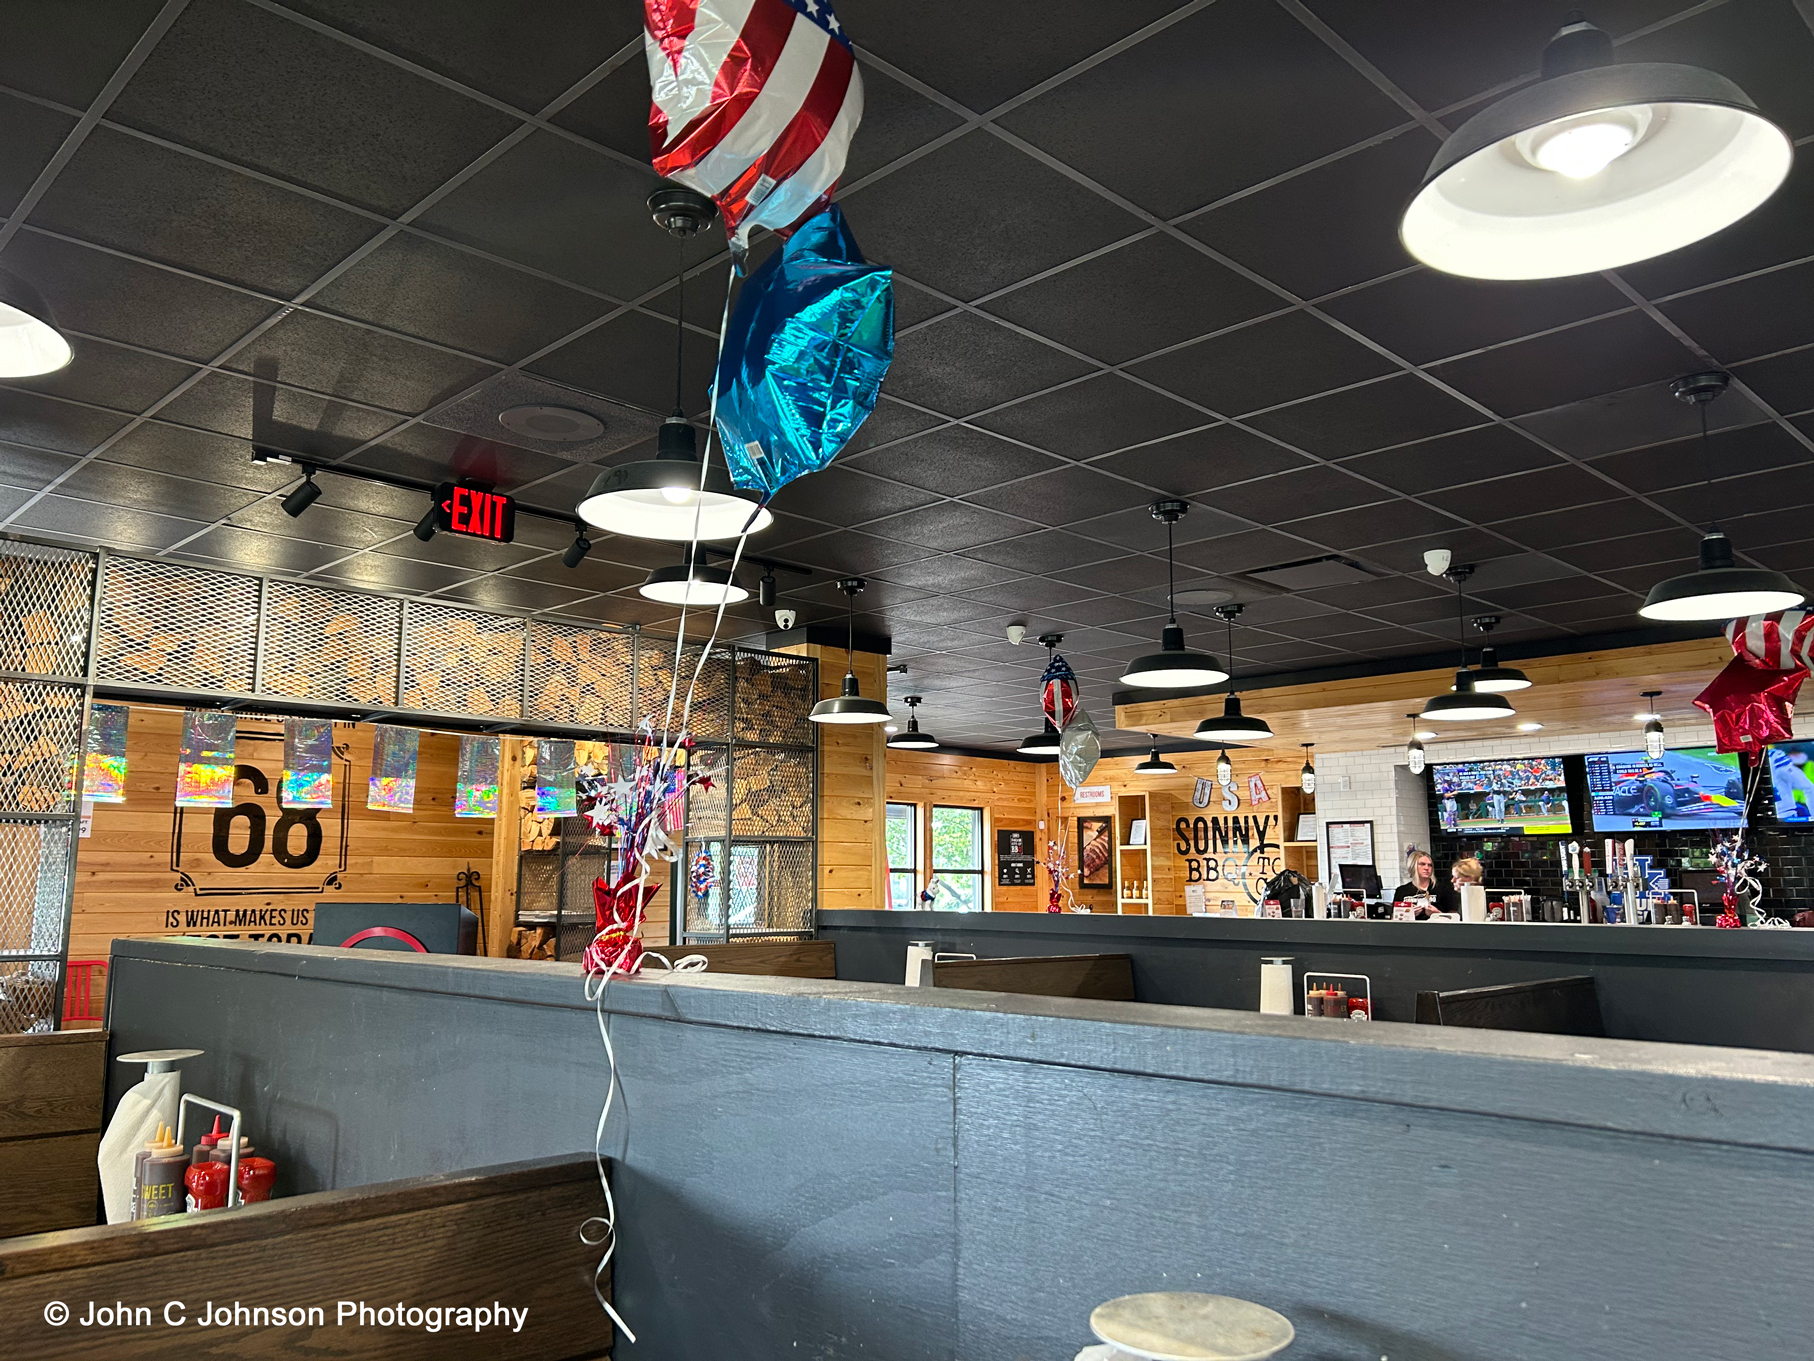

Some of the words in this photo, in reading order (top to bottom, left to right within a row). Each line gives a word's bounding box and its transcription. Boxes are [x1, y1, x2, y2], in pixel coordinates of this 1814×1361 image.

[451, 486, 507, 539] EXIT
[1079, 790, 1105, 799] RESTROOMS
[211, 764, 323, 869] 68
[1185, 857, 1241, 887] BBQ
[165, 909, 181, 928] IS
[186, 908, 231, 928] WHAT
[234, 908, 287, 927] MAKES
[290, 908, 310, 927] US
